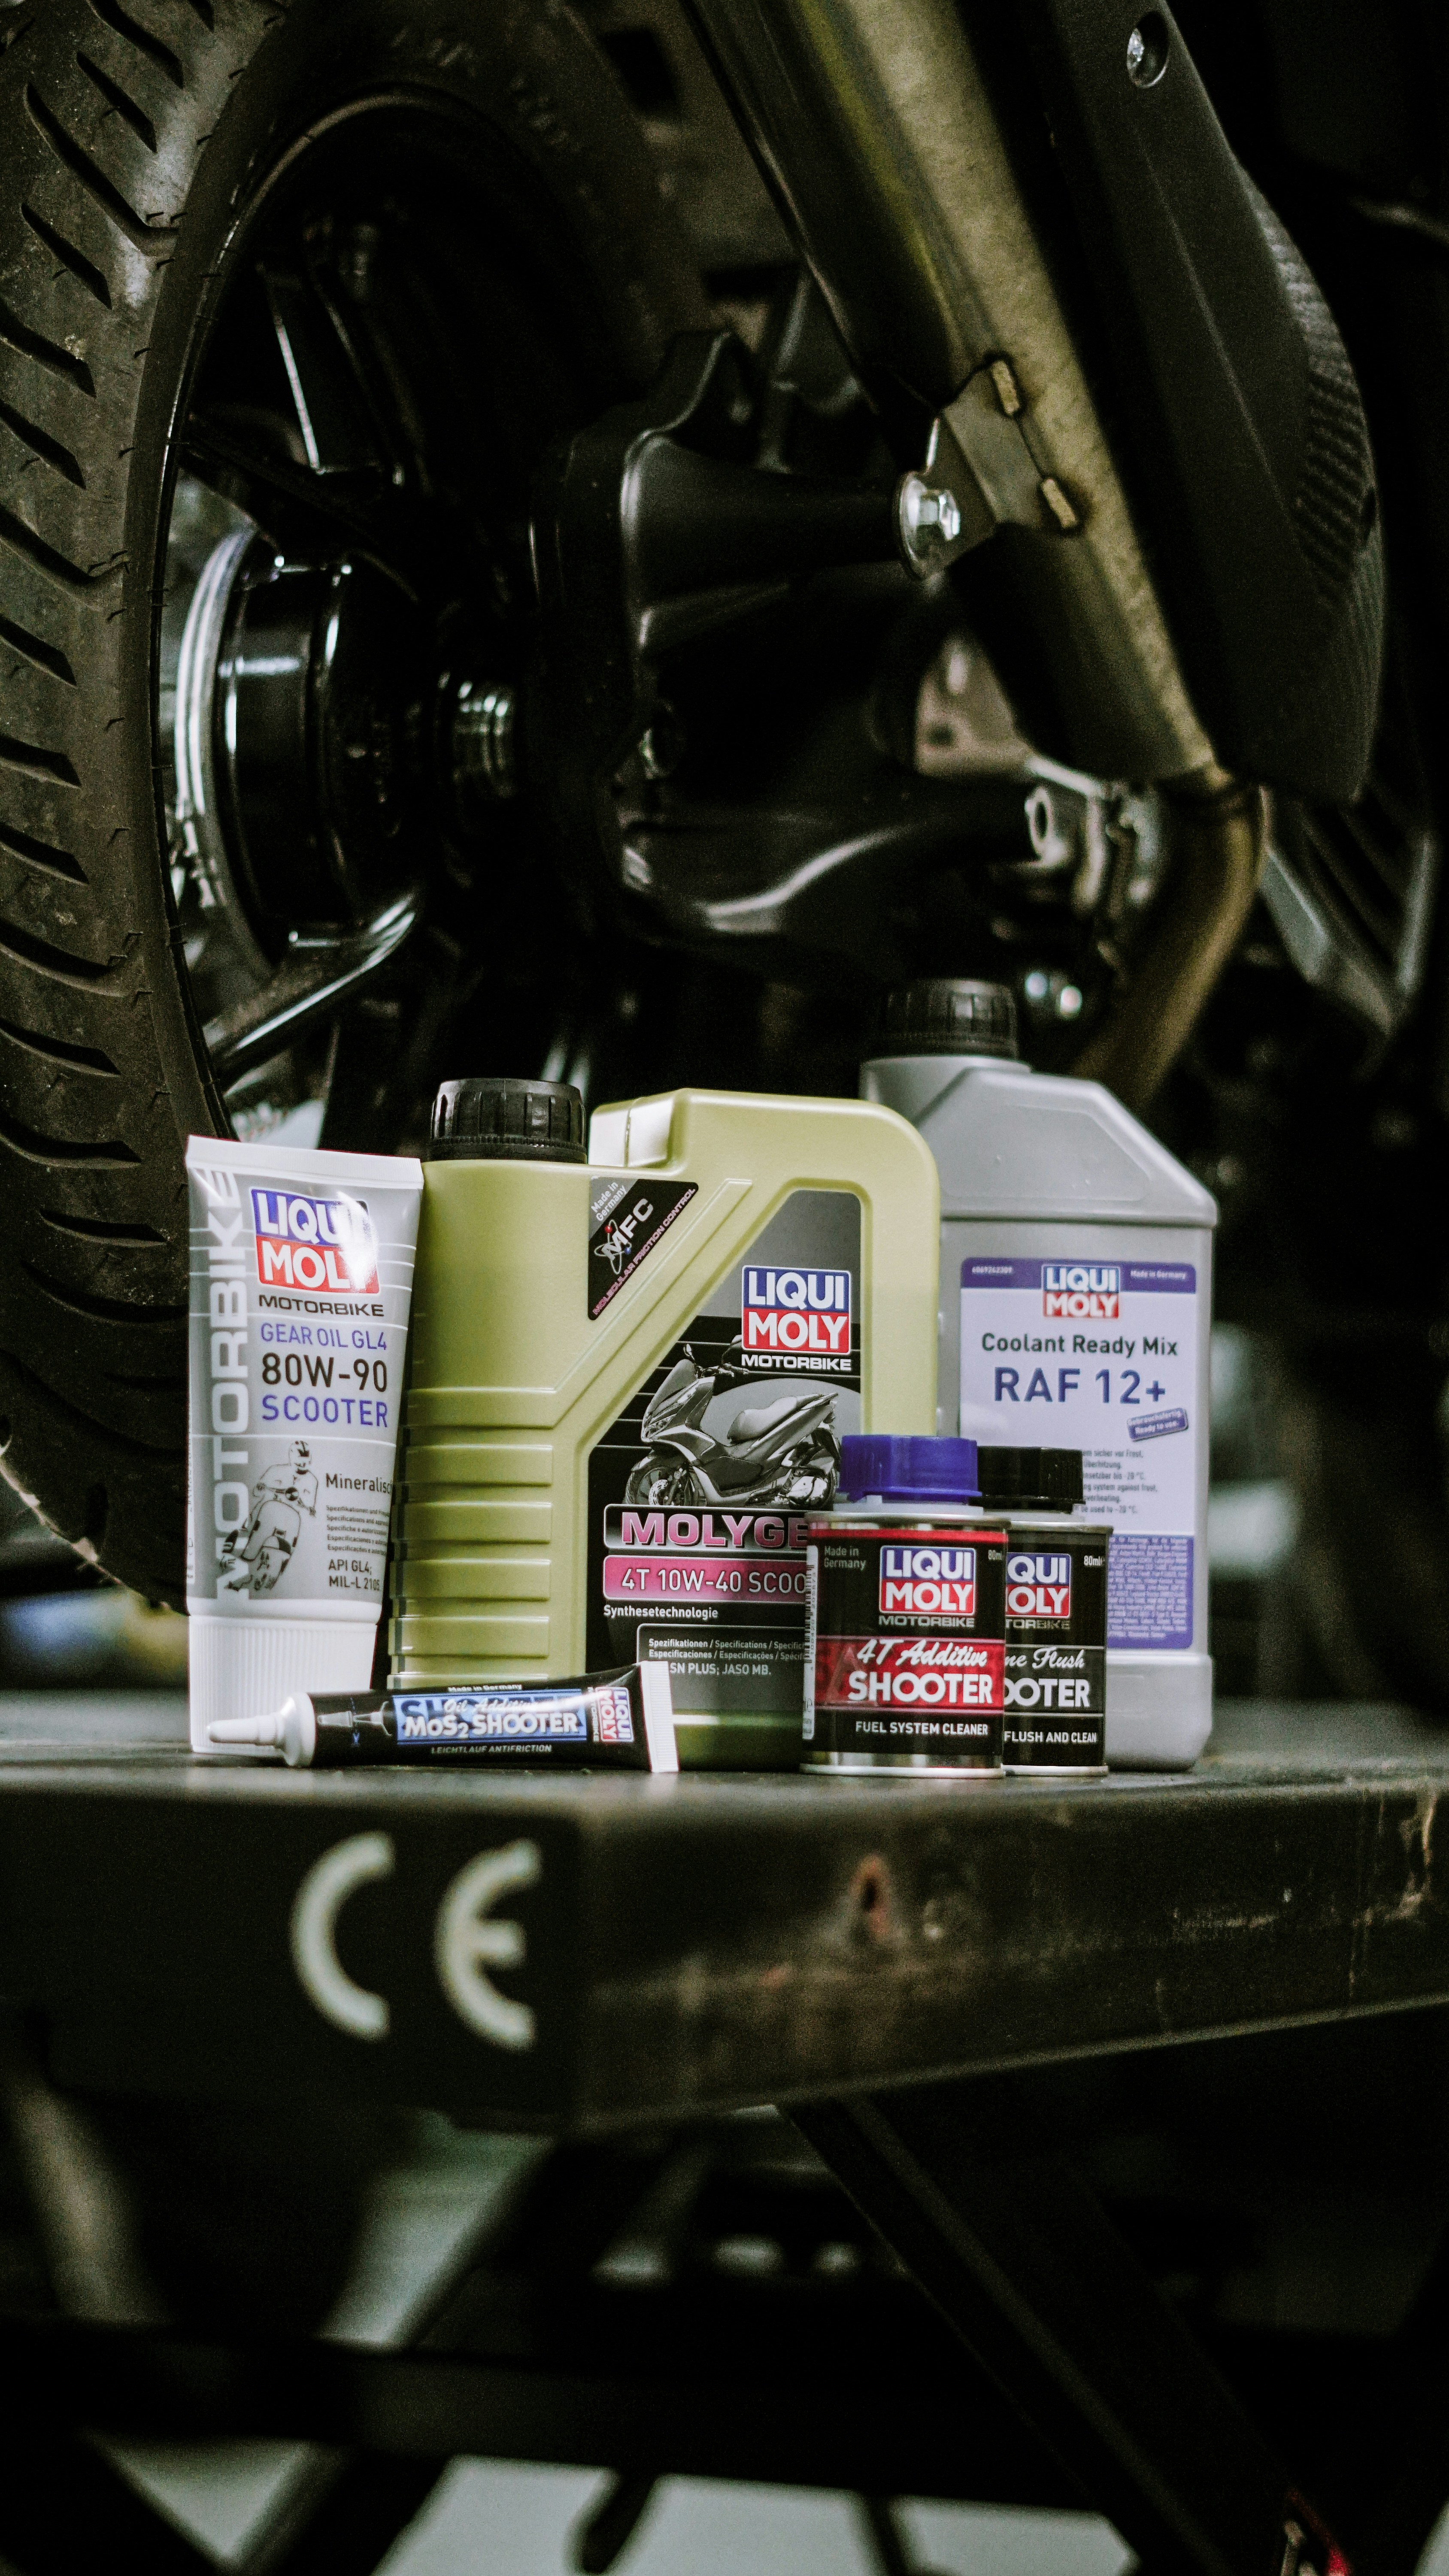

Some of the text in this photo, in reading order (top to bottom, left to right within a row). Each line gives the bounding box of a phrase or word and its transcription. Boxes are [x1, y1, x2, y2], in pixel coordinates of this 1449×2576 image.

[591, 1182, 618, 1213] Made in
[596, 1185, 627, 1221] Germany
[257, 1193, 371, 1246] LIQU
[601, 1198, 654, 1261] MFC
[592, 1188, 695, 1315] MOLECULAR FRICTION CONTROL
[749, 1271, 844, 1311] LIQUI
[1046, 1267, 1116, 1292] LIQUI
[259, 1294, 384, 1317] MOTORBIKE
[1046, 1293, 1117, 1317] MOLY
[261, 1322, 387, 1350] GEAR OIL GL4
[749, 1311, 847, 1349] MOLY
[982, 1333, 1178, 1358] Coolant Ready Mix
[262, 1352, 387, 1392] 80W-90
[741, 1354, 851, 1371] MOTORBIKE
[209, 1169, 249, 1601] MOTORBIKE
[994, 1367, 1166, 1404] RAF 12+
[262, 1394, 388, 1428] SCOOTER
[621, 1512, 807, 1549] MOLYGE
[824, 1546, 859, 1556] Made in
[824, 1557, 866, 1571] Germany
[328, 1559, 372, 1575] API GL4;
[886, 1549, 971, 1580] LIQUI
[1007, 1555, 1067, 1584] QUI
[329, 1575, 361, 1589] MIL-L
[622, 1568, 806, 1594] 4T 10W-40 SCOO
[885, 1582, 973, 1611] MOLY
[1006, 1586, 1069, 1613] OLY
[603, 1604, 718, 1621] Synthesetechnologie
[878, 1615, 975, 1628] MOTORBIKE
[1006, 1619, 1070, 1630] TORBIKE
[649, 1638, 708, 1649] Spezifikationen
[715, 1640, 767, 1649] Specifications
[649, 1649, 712, 1659] Especificaciones
[719, 1650, 774, 1660] Especificações
[857, 1638, 904, 1665] 4T
[895, 1638, 987, 1667] Additive
[670, 1662, 772, 1676] SN PLUS; JASO MB.
[1032, 1647, 1085, 1669] Flush
[847, 1670, 993, 1704] SHOOTER
[1004, 1677, 1090, 1708] OTER
[444, 1698, 468, 1713] Oil
[588, 1686, 600, 1742] MTORBIKE
[613, 1690, 631, 1739] LIQUI
[473, 1712, 579, 1736] SHOOTER
[855, 1721, 988, 1736] FUEL SYSTEM CLEANER
[431, 1744, 552, 1755] LEICHTLAUF ANTIFRICTION
[1004, 1731, 1097, 1744] FLUSH AND CLEAN
